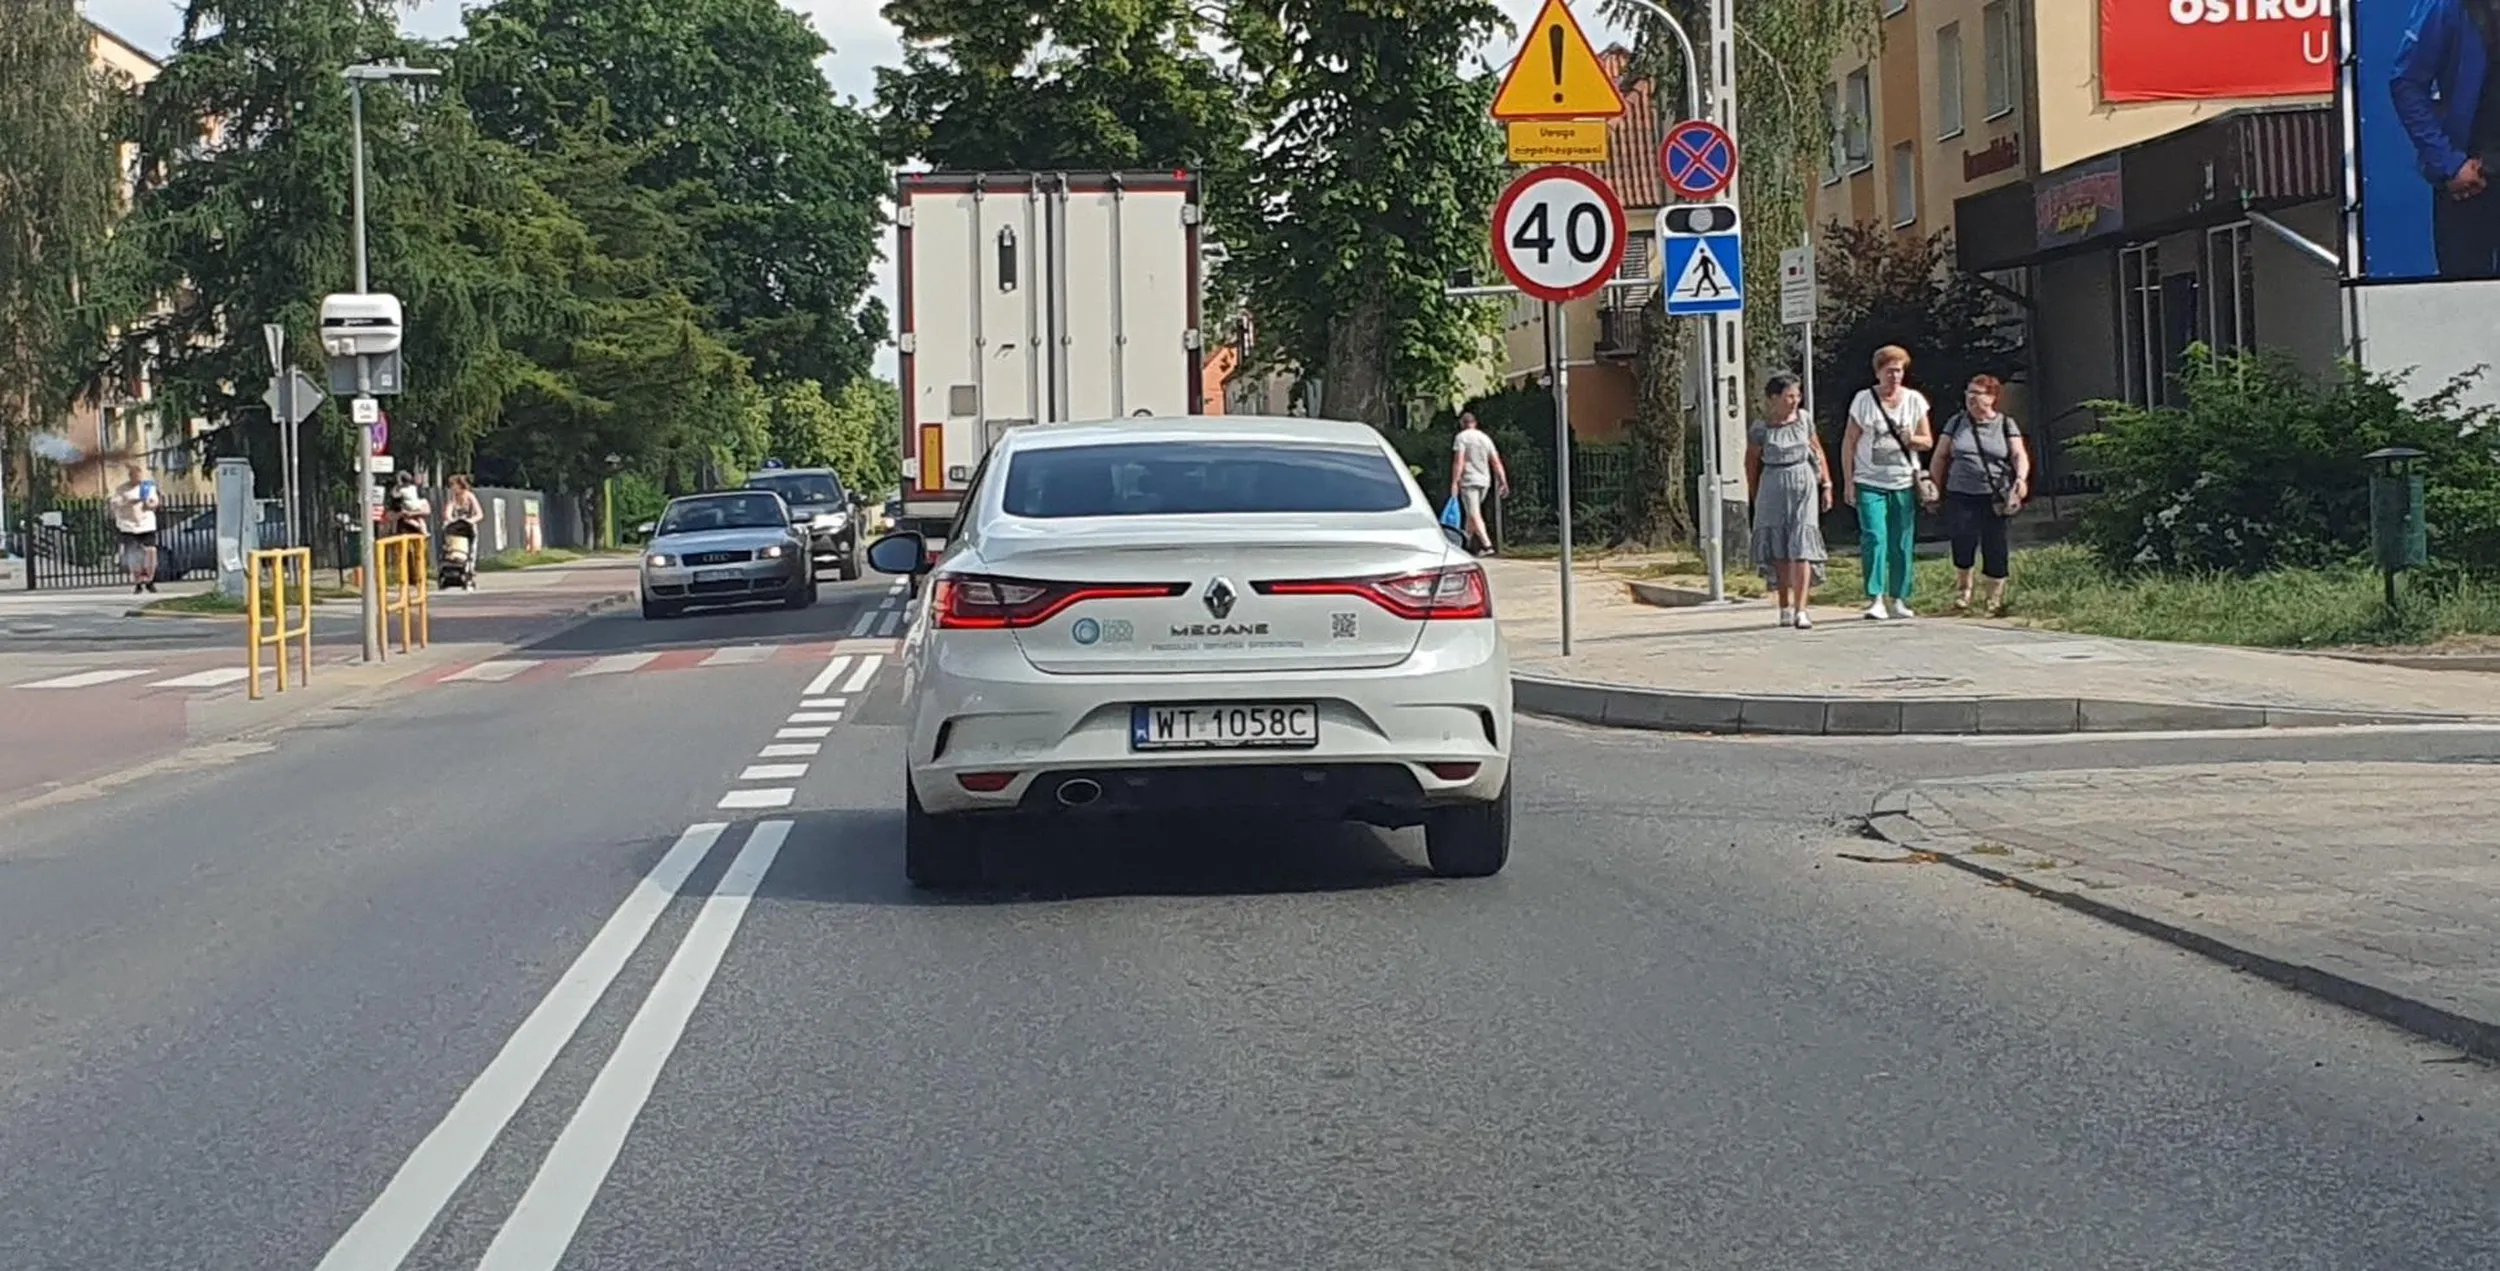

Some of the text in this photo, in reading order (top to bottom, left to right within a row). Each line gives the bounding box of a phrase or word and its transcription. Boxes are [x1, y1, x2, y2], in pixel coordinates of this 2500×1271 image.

[1512, 202, 1606, 264] 40
[1169, 623, 1270, 637] MEGANE
[1155, 708, 1308, 739] WT 1058C
